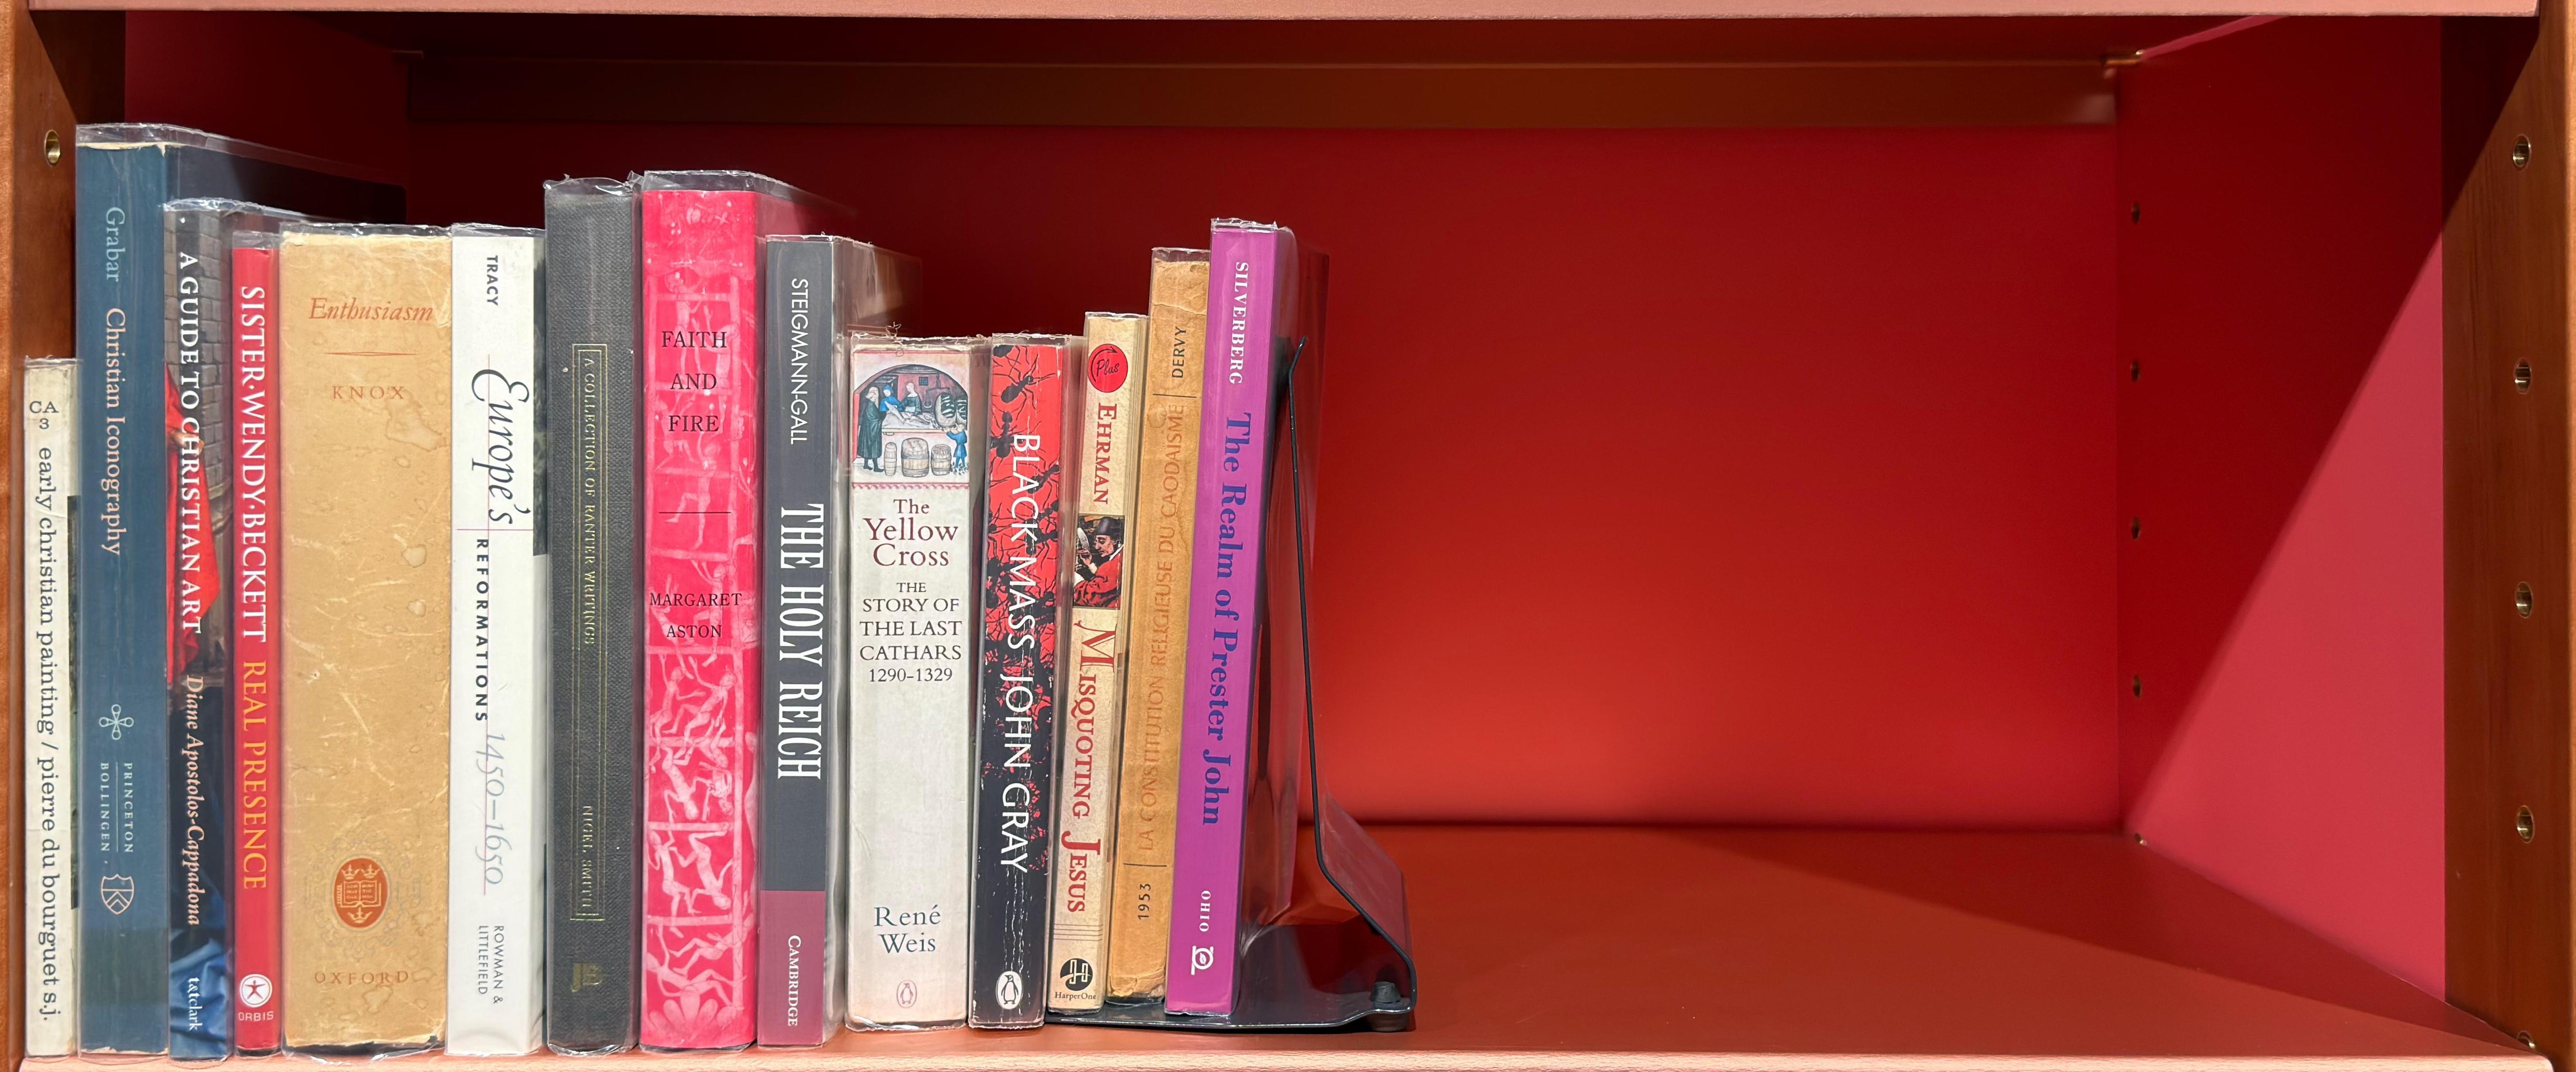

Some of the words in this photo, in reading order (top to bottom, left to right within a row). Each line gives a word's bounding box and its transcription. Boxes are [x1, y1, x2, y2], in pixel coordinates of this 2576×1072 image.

[106, 207, 126, 281] Grabar
[180, 252, 198, 269] A
[309, 297, 433, 321] Enthusiasm
[486, 256, 498, 306] TRACY
[180, 277, 199, 365] GUIDE
[662, 332, 727, 348] FAITH
[1229, 262, 1249, 384] SILVERBERG
[107, 308, 126, 409] Christian
[670, 374, 717, 390] AND
[791, 278, 809, 444] STEIGMANN-GALL
[1097, 359, 1120, 377] Plus
[1172, 327, 1186, 378] DERVY
[29, 401, 59, 413] CA
[181, 370, 199, 410] TO
[333, 385, 405, 400] KNOX
[39, 419, 49, 429] 3
[585, 373, 595, 470] COLLECTION
[668, 415, 719, 432] FIRE
[1223, 412, 1251, 472] The
[35, 448, 57, 511] early
[1093, 403, 1117, 504] EHRMAN
[101, 417, 126, 556] Iconography
[181, 417, 200, 572] CHRISTIAN
[585, 478, 595, 496] OF
[894, 499, 929, 514] The
[1011, 435, 1040, 542] BLACK
[585, 505, 595, 564] RANTER
[780, 504, 824, 568] THE
[863, 518, 958, 541] Yellow
[873, 544, 949, 566] Cross
[1158, 523, 1175, 553] DU
[1216, 484, 1246, 579] Realm
[37, 518, 57, 625] christian
[650, 593, 741, 606] MARGARET
[897, 582, 926, 592] THE
[182, 580, 201, 633] ART
[475, 539, 489, 721] REFORMATIONS
[584, 572, 595, 644] WRITINGS
[667, 625, 722, 637] ASTON
[780, 584, 823, 667] HOLY
[860, 621, 904, 636] THE
[910, 621, 962, 636] LAST
[863, 599, 928, 612] STORY
[933, 599, 959, 612] OF
[1008, 556, 1036, 649] MASS
[1150, 560, 1173, 666] RELIGIEUSE
[1215, 589, 1238, 621] of
[860, 645, 961, 660] CATHARS
[37, 631, 57, 735] painting
[184, 674, 204, 729] Diane
[243, 661, 267, 732] REAL
[1208, 627, 1238, 741] Prester
[778, 681, 822, 779] REICH
[1001, 674, 1033, 767] JOHN
[1071, 620, 1117, 818] MISQUOTING
[1139, 674, 1166, 822] CONSTITUTION
[38, 757, 59, 831] pierre
[100, 763, 110, 851] BOLLINGEN
[124, 763, 133, 852] PRINCETON
[243, 742, 267, 890] PRESENCE
[1202, 749, 1231, 825] John
[43, 837, 60, 869] du
[181, 733, 205, 926] Apostolos-Cappadona
[1000, 783, 1030, 873] GRAY
[1138, 830, 1154, 850] LA
[1061, 831, 1101, 913] JESUS
[1138, 884, 1151, 919] 1953
[38, 874, 60, 986] bourguet
[874, 905, 941, 927] René
[1199, 890, 1211, 932] OHIO
[478, 926, 489, 995] LITTLEFIELD
[493, 926, 504, 990] ROWMAN
[878, 933, 936, 954] Weis
[39, 992, 60, 1021] s.j.
[187, 977, 203, 1030] t&tclark
[315, 971, 409, 984] OXFORD
[787, 935, 801, 1026] CAMBRIDGE
[1055, 992, 1096, 1000] HarperOne
[238, 1011, 274, 1021] ORBIS
